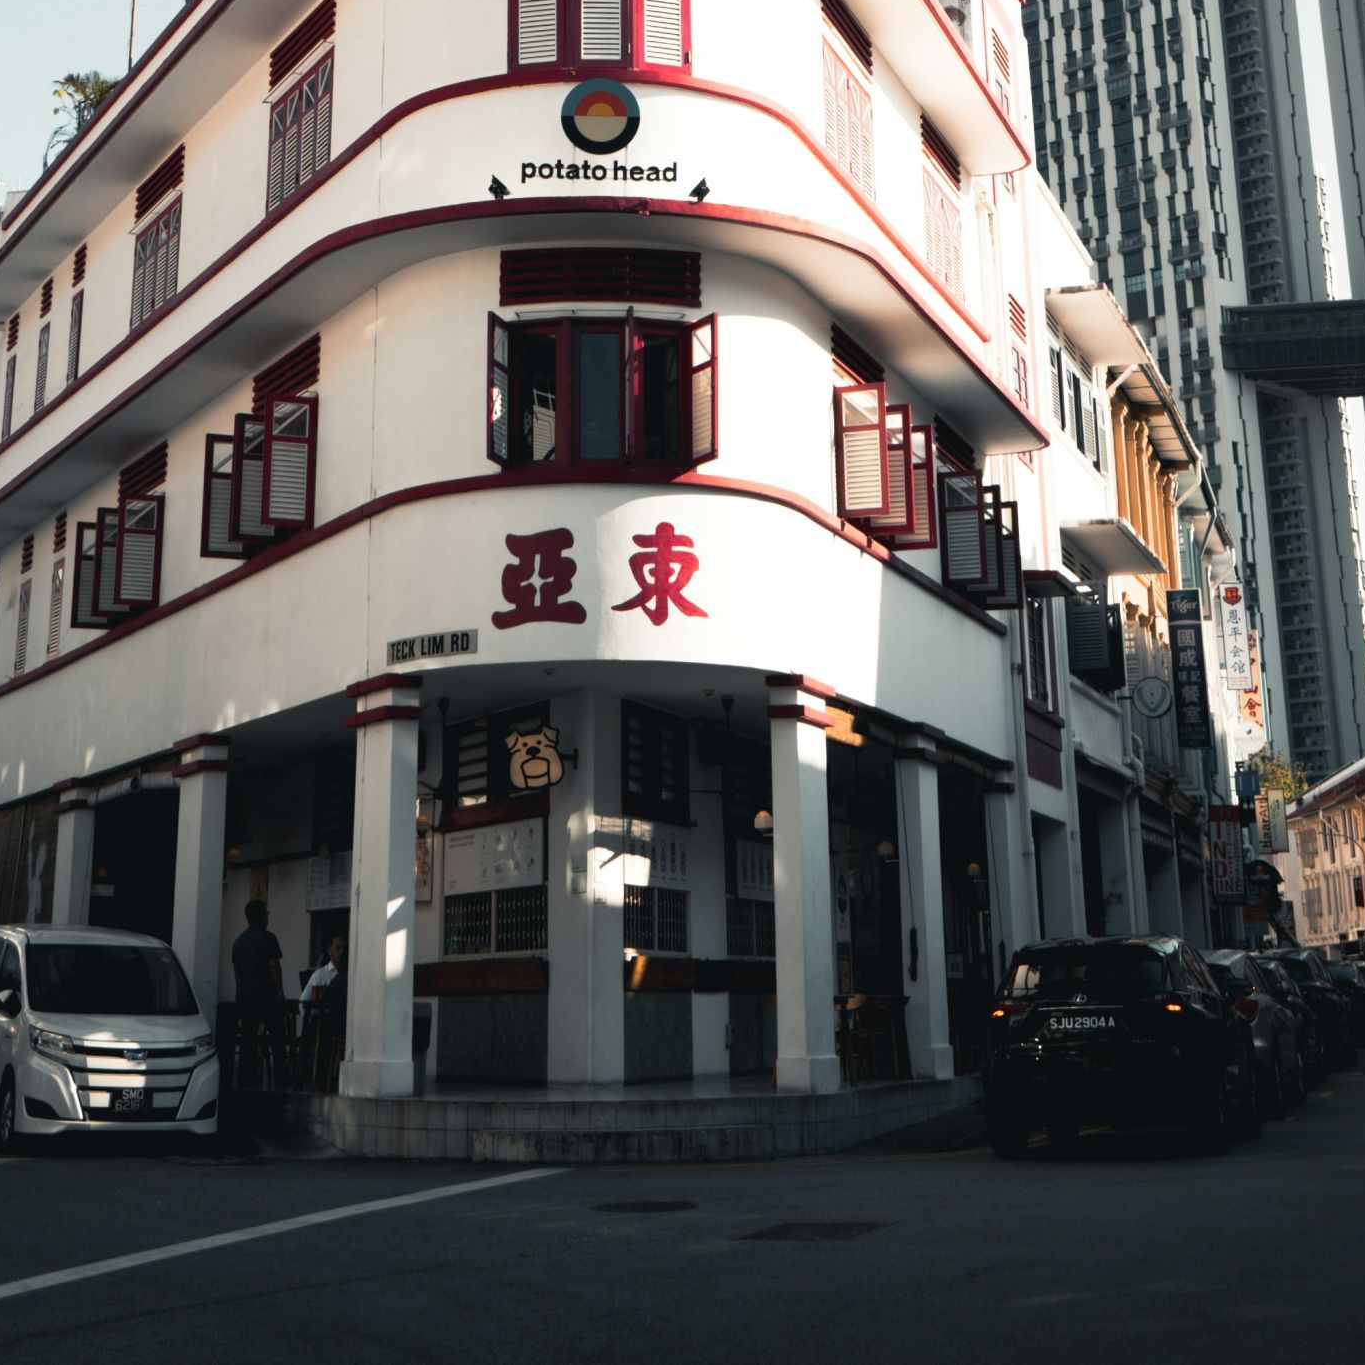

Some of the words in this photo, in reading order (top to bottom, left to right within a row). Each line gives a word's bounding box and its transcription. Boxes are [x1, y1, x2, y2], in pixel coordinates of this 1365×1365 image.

[521, 158, 607, 184] potato
[613, 158, 677, 182] head
[1170, 597, 1198, 614] Tiger
[390, 638, 416, 662] TECK
[420, 634, 445, 656] LIM
[450, 632, 470, 653] RD
[1049, 1015, 1115, 1030] SJU2904A
